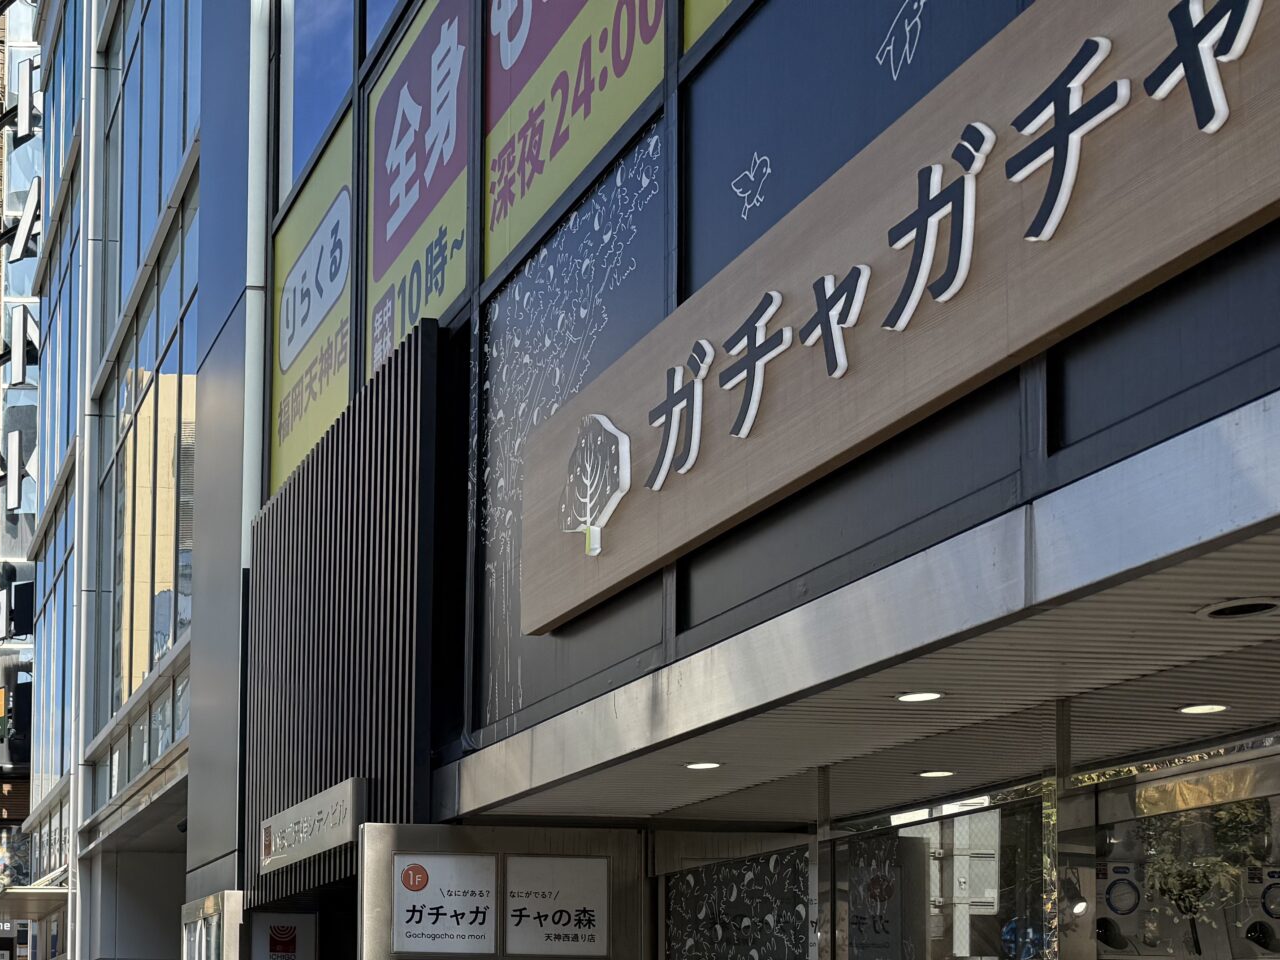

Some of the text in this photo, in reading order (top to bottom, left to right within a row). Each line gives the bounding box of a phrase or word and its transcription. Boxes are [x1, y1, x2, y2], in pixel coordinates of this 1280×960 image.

[285, 220, 343, 347] りらくる
[278, 317, 349, 447] 福岡天神店
[408, 871, 422, 886] 1F
[405, 931, 454, 941] Gachagacha
[468, 931, 486, 941] mori
[544, 933, 596, 943] 天神西通り店
